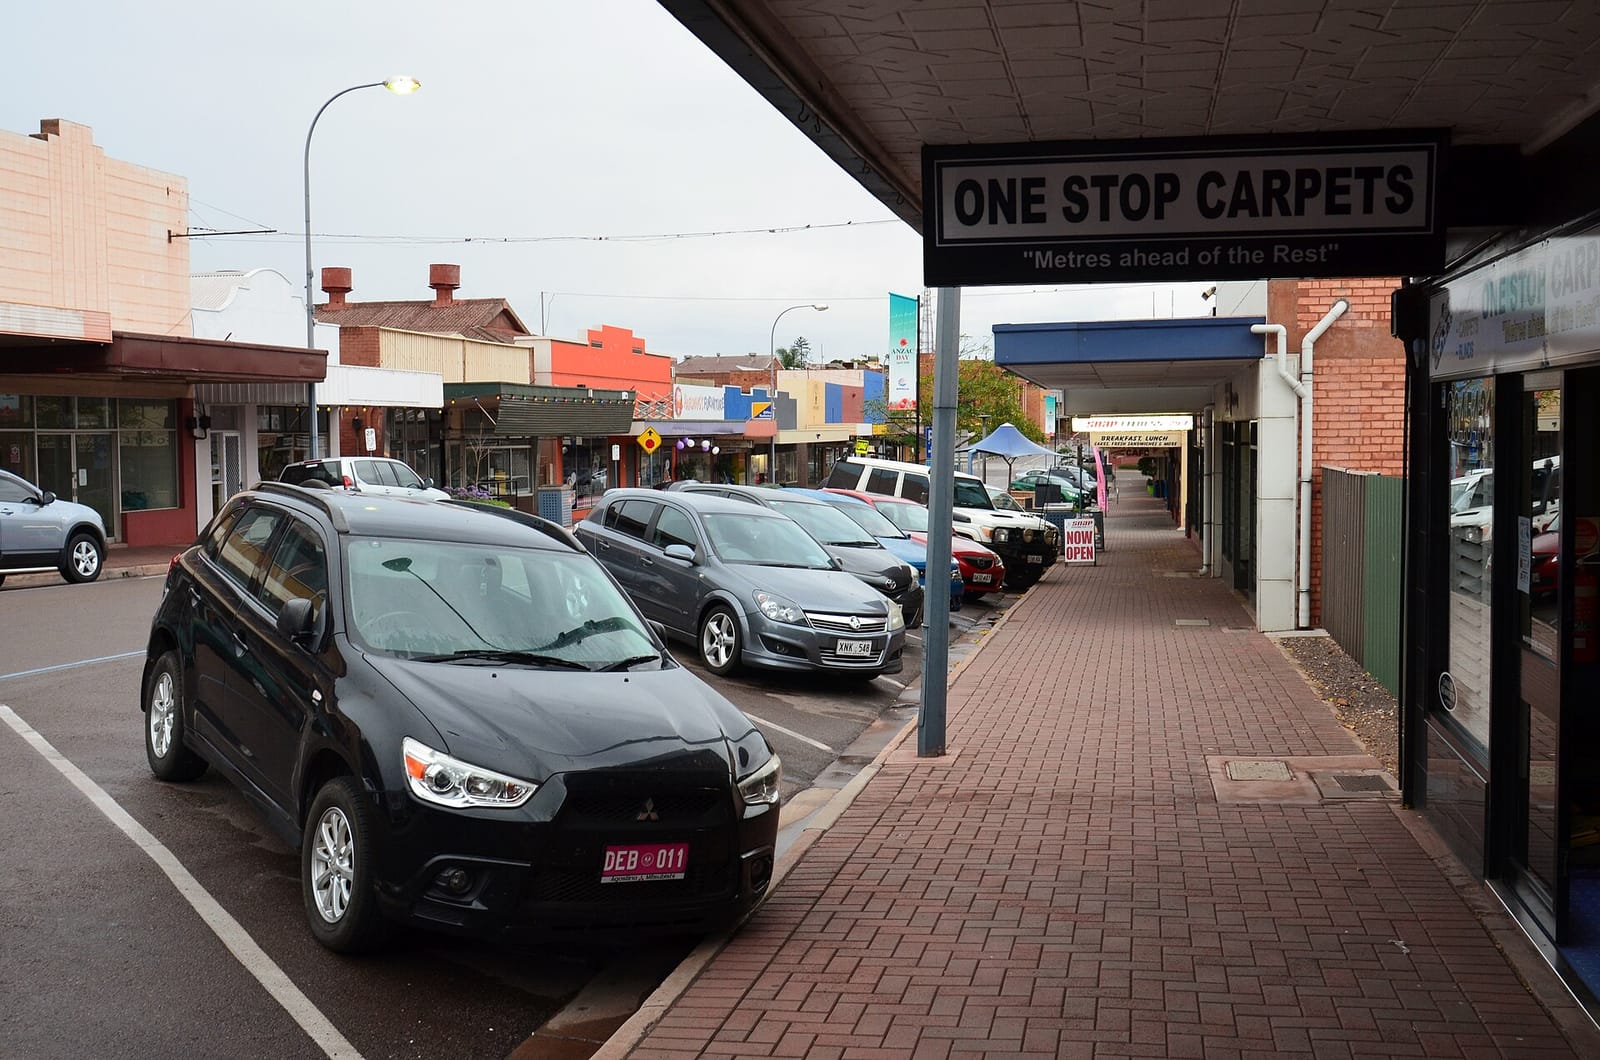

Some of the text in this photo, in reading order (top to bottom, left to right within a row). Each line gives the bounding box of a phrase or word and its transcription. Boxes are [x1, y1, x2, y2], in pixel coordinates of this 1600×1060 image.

[954, 164, 1414, 226] ONE STOP CARPETS
[1023, 243, 1339, 269] "Metres ahead of the Rest"
[1482, 279, 1506, 320] ONE
[1509, 270, 1546, 313] STOP
[1066, 531, 1093, 545] NOW
[1066, 546, 1094, 560] OPEN
[839, 642, 854, 652] XNK
[603, 848, 684, 871] DEB 011
